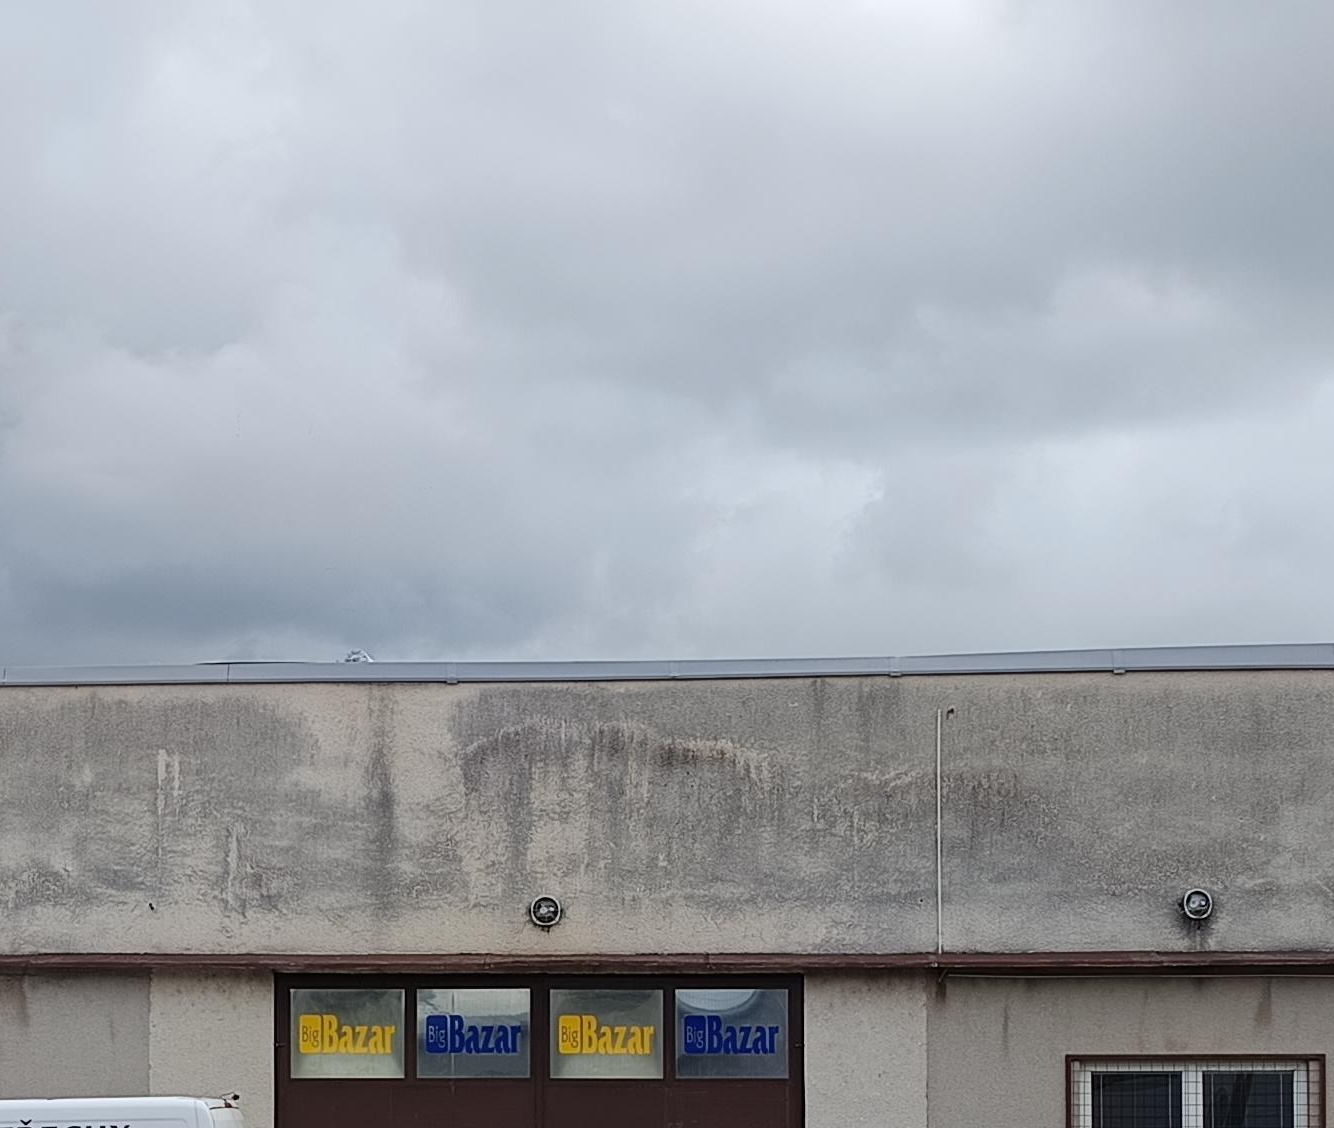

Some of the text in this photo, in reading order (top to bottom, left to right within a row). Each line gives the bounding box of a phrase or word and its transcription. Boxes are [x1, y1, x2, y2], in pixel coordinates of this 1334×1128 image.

[301, 1014, 395, 1054] Big Bazar
[428, 1014, 521, 1054] Big Bazar
[561, 1014, 654, 1054] Big Bazar
[686, 1015, 779, 1054] Big Bazar
